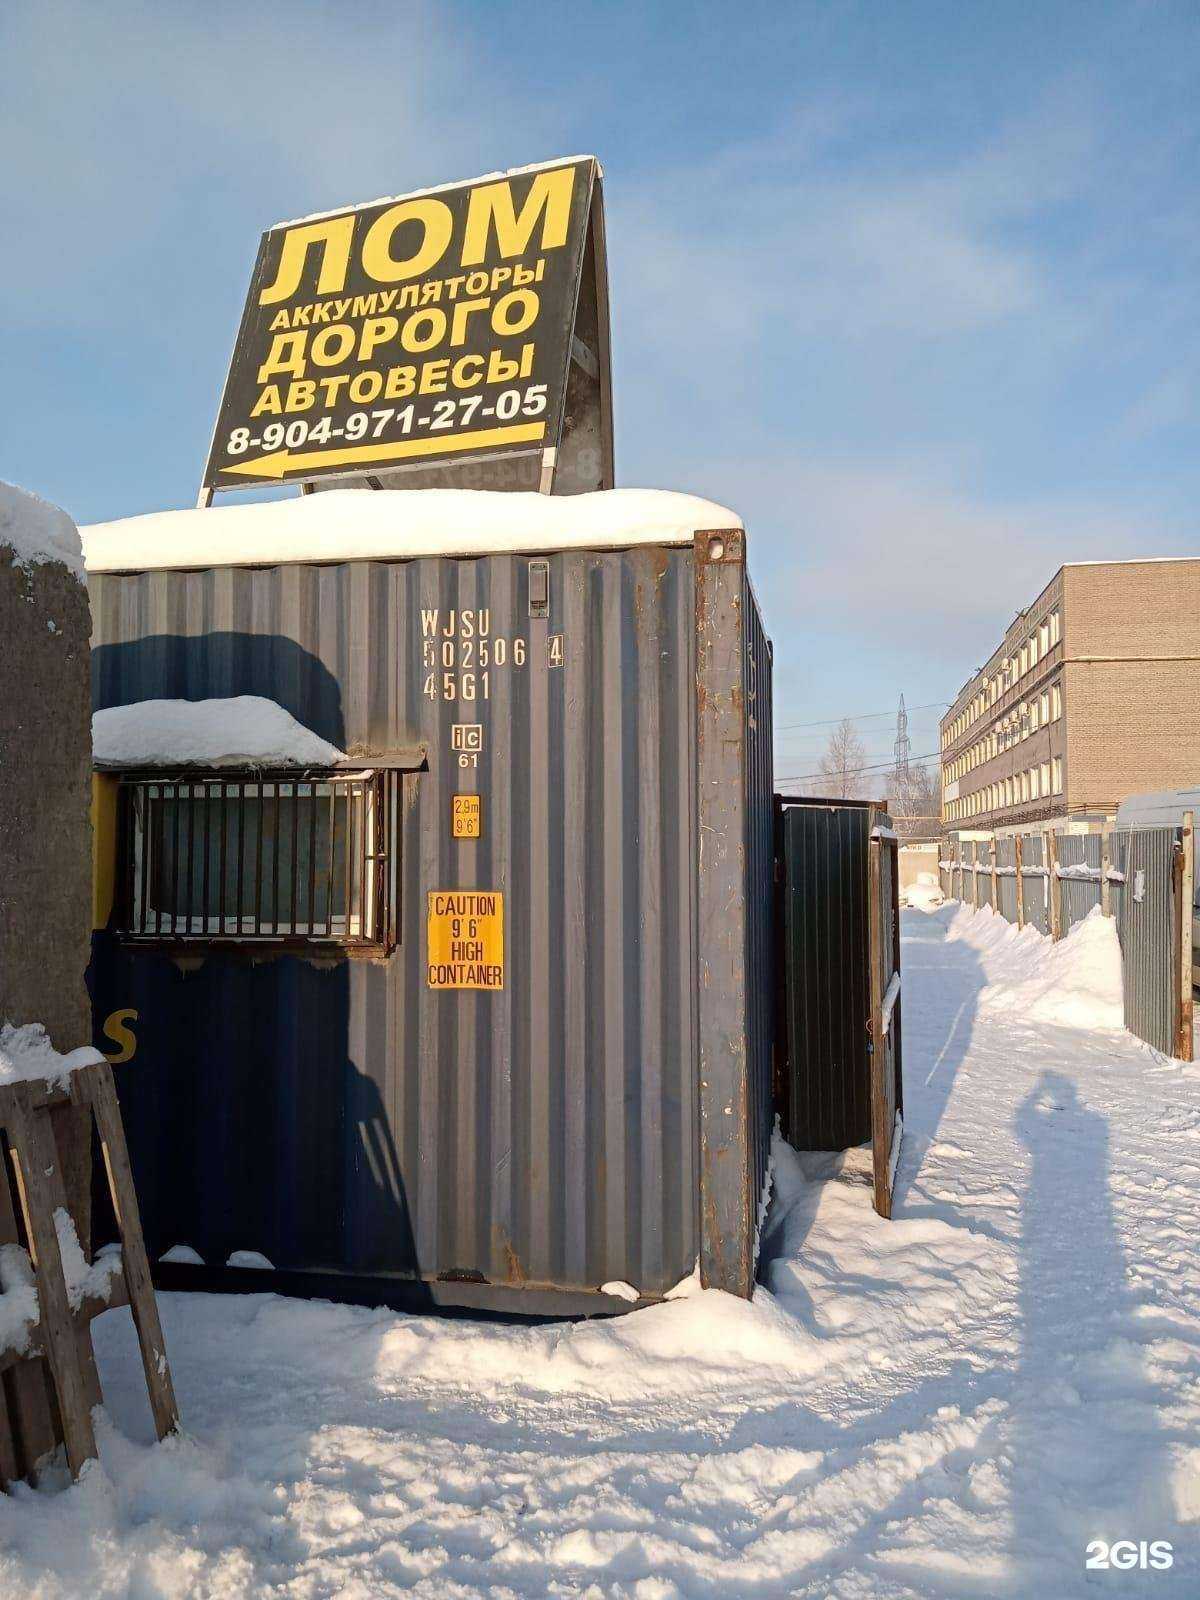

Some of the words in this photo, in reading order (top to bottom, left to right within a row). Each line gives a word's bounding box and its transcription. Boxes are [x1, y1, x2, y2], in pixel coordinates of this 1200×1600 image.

[259, 167, 576, 306] ЛОМ
[269, 259, 546, 331] АККУМУЛЯТОРЫ
[257, 289, 541, 384] ДОРОГО
[249, 343, 536, 418] АВТОВЕСЫ
[226, 384, 549, 456] 8-904-971-27-05
[550, 637, 563, 665] 4
[458, 753, 479, 768] 61
[435, 896, 496, 916] CAUTION
[428, 965, 502, 986] CONTAINER
[451, 942, 483, 961] HIGH
[103, 1008, 139, 1064] S
